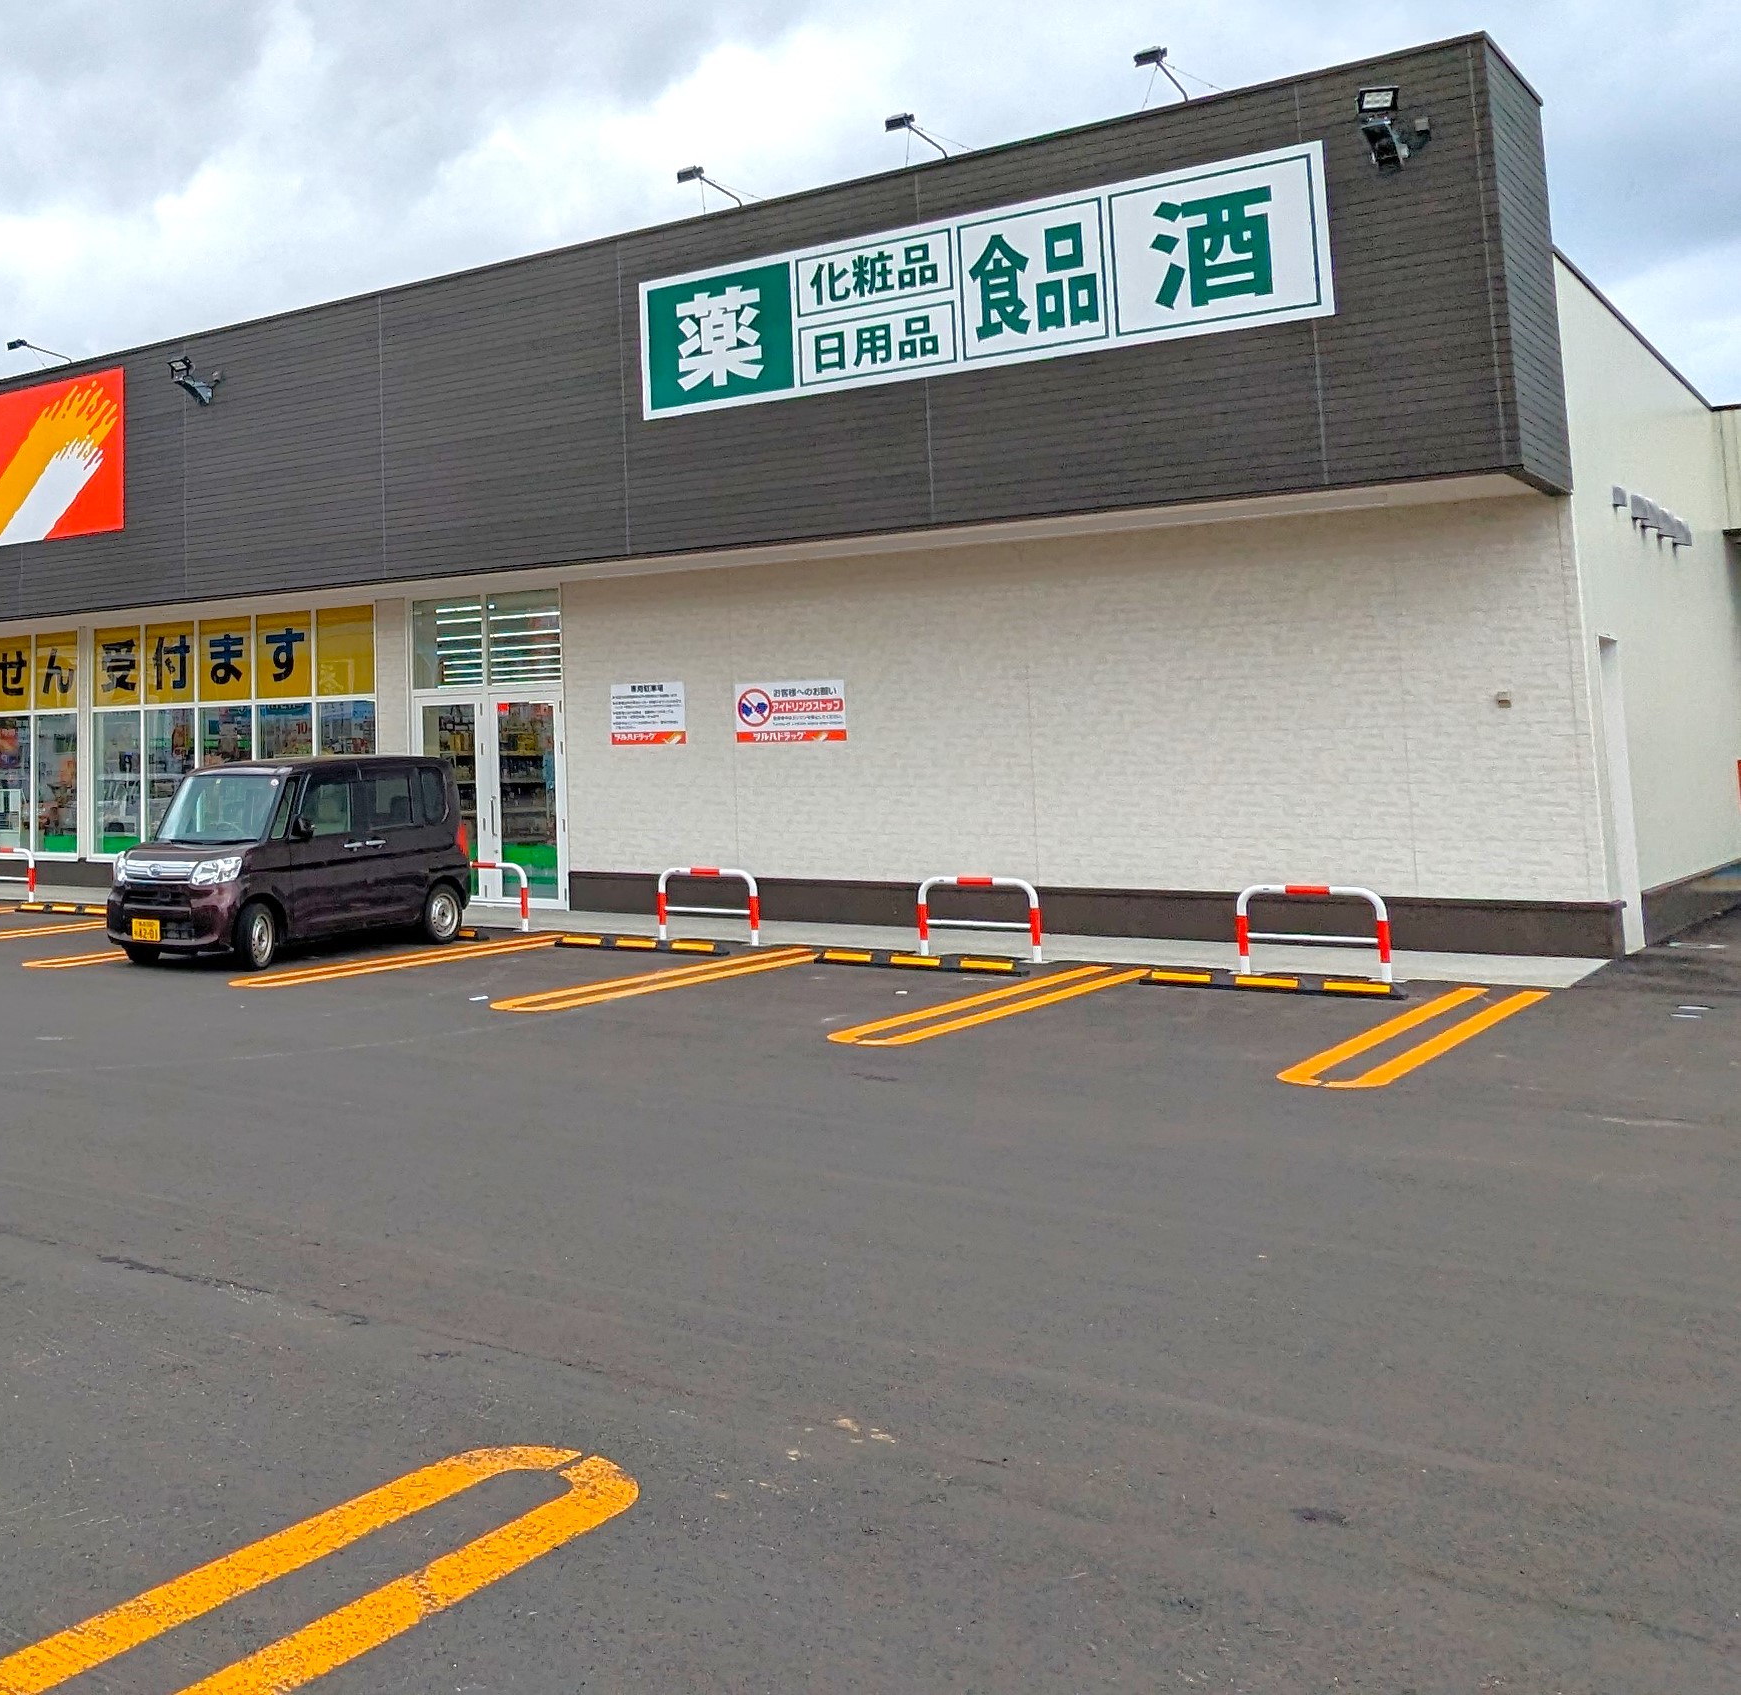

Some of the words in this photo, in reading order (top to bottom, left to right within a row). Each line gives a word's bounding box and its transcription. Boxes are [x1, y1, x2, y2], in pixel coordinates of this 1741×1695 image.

[808, 243, 939, 306] 化粧品
[969, 222, 1100, 343] 食品
[1149, 185, 1274, 311] 酒
[676, 284, 764, 394] 薬
[813, 314, 940, 374] 日用品
